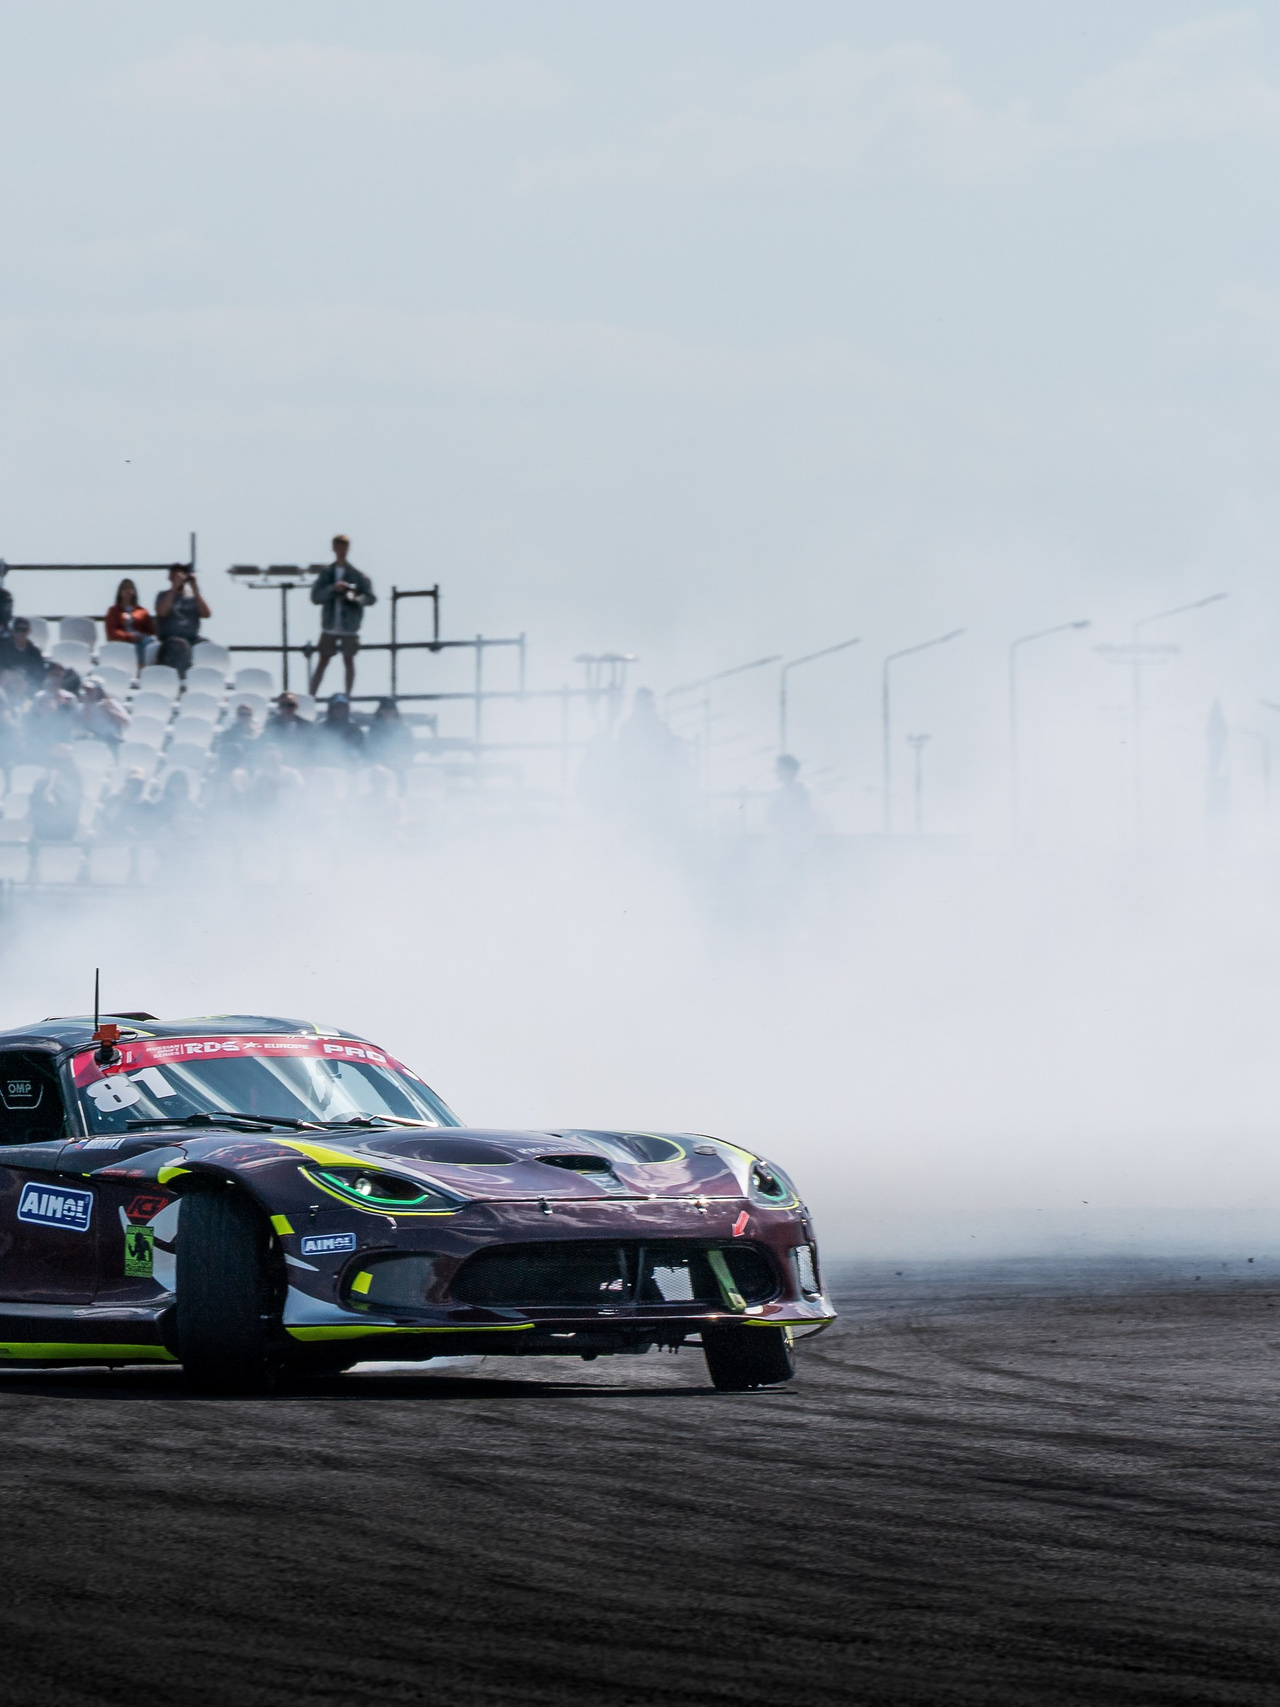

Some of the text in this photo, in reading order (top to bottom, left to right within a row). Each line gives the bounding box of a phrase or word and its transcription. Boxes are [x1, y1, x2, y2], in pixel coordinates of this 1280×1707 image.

[184, 1041, 241, 1054] RDS
[323, 1043, 387, 1063] PRO
[8, 1084, 32, 1094] OMP
[86, 1066, 177, 1112] 81
[21, 1192, 86, 1222] AIMOL
[305, 1237, 352, 1251] AIMOL
